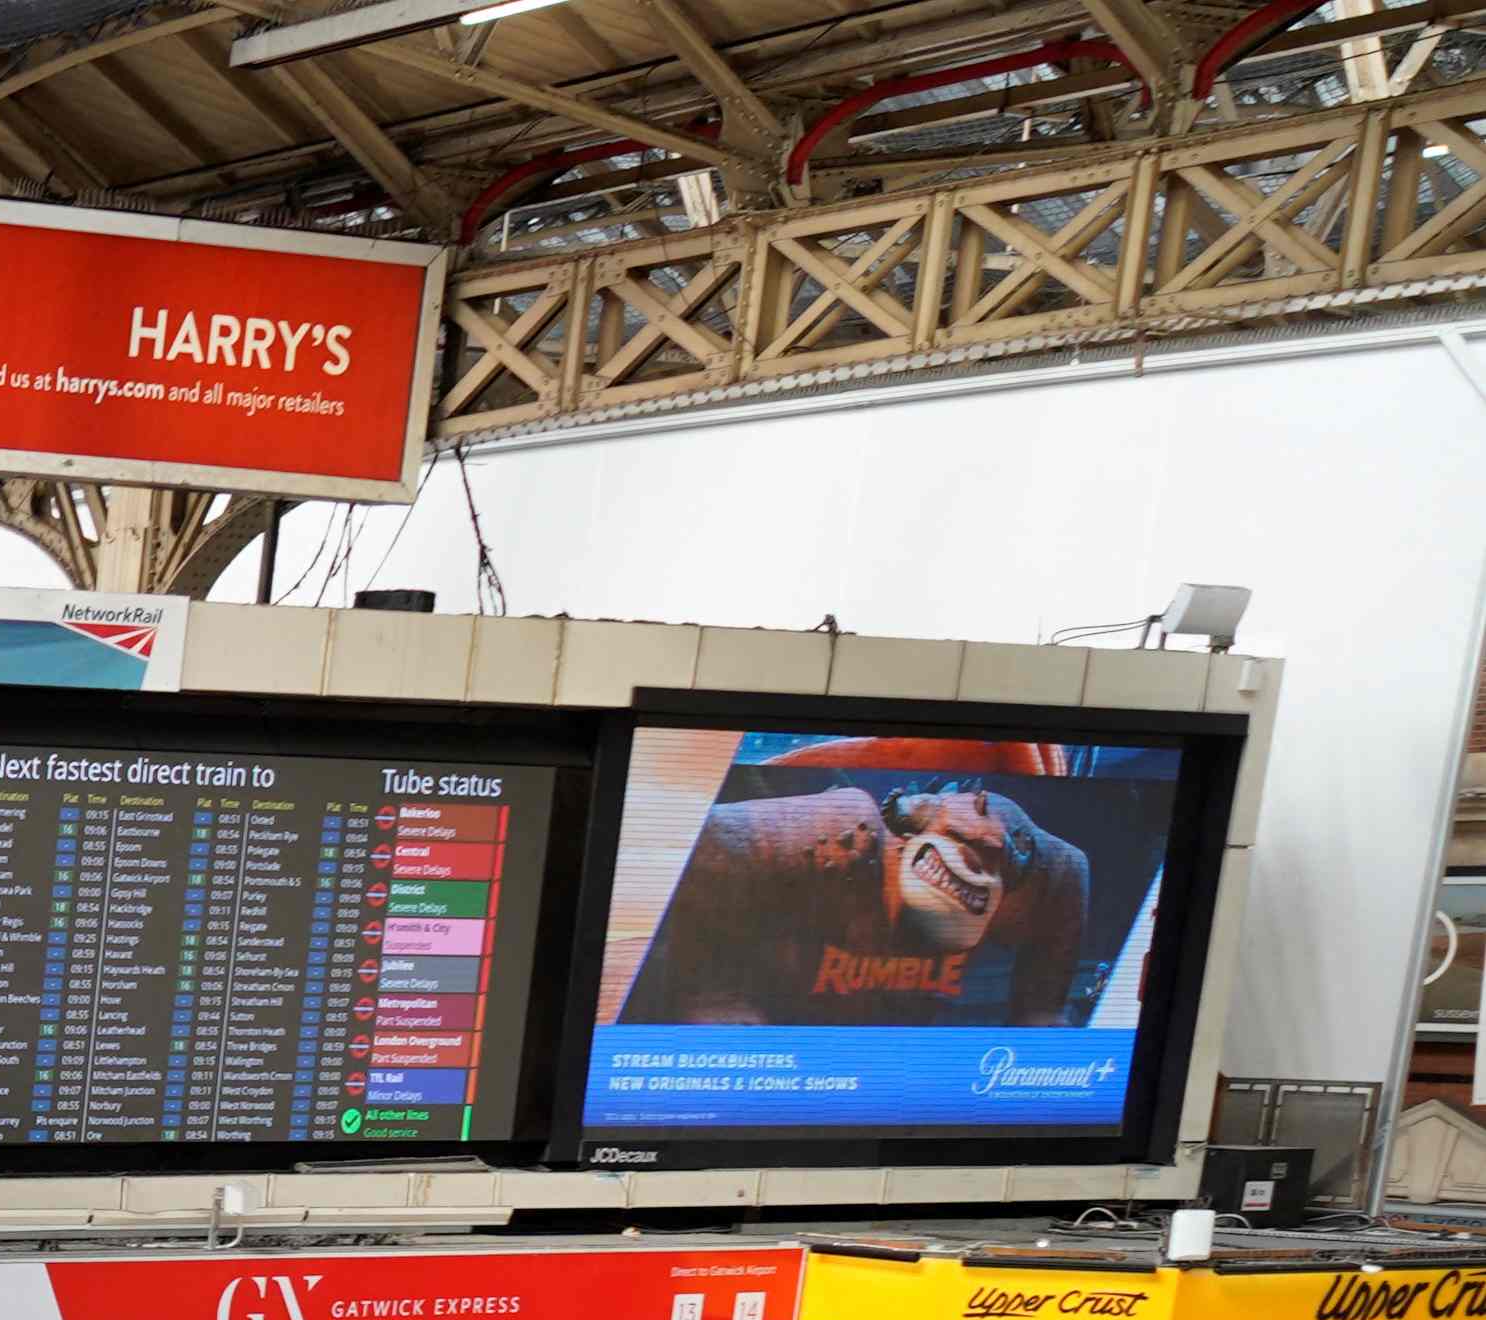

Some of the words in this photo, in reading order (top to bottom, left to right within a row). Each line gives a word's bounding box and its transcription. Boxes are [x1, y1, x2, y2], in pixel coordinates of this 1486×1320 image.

[129, 307, 351, 375] HARRY'S
[10, 371, 31, 389] us
[33, 373, 52, 391] at
[56, 366, 165, 404] harrys.com
[168, 381, 200, 402] and
[202, 382, 224, 404] all
[226, 386, 275, 416] major
[278, 392, 344, 416] retailers
[47, 754, 122, 782] fastest
[127, 757, 191, 785] direct
[196, 761, 246, 786] train
[252, 765, 275, 788] to
[382, 769, 434, 795] Tube
[438, 774, 502, 797] status
[813, 945, 967, 995] RUMBLE
[612, 1054, 674, 1068] STREAM
[677, 1054, 797, 1069] BLOCKBUSTERS,
[609, 1076, 645, 1090] NEW
[648, 1076, 730, 1090] ORIGINALS
[733, 1077, 744, 1090] &
[748, 1076, 801, 1090] ICONIC
[804, 1077, 858, 1090] SHOWS
[590, 1147, 658, 1163] JCDecaux
[331, 1299, 425, 1318] GATWICK
[434, 1296, 520, 1315] EXPRESS
[963, 1288, 1056, 1319] Upper
[1058, 1290, 1149, 1317] Crust
